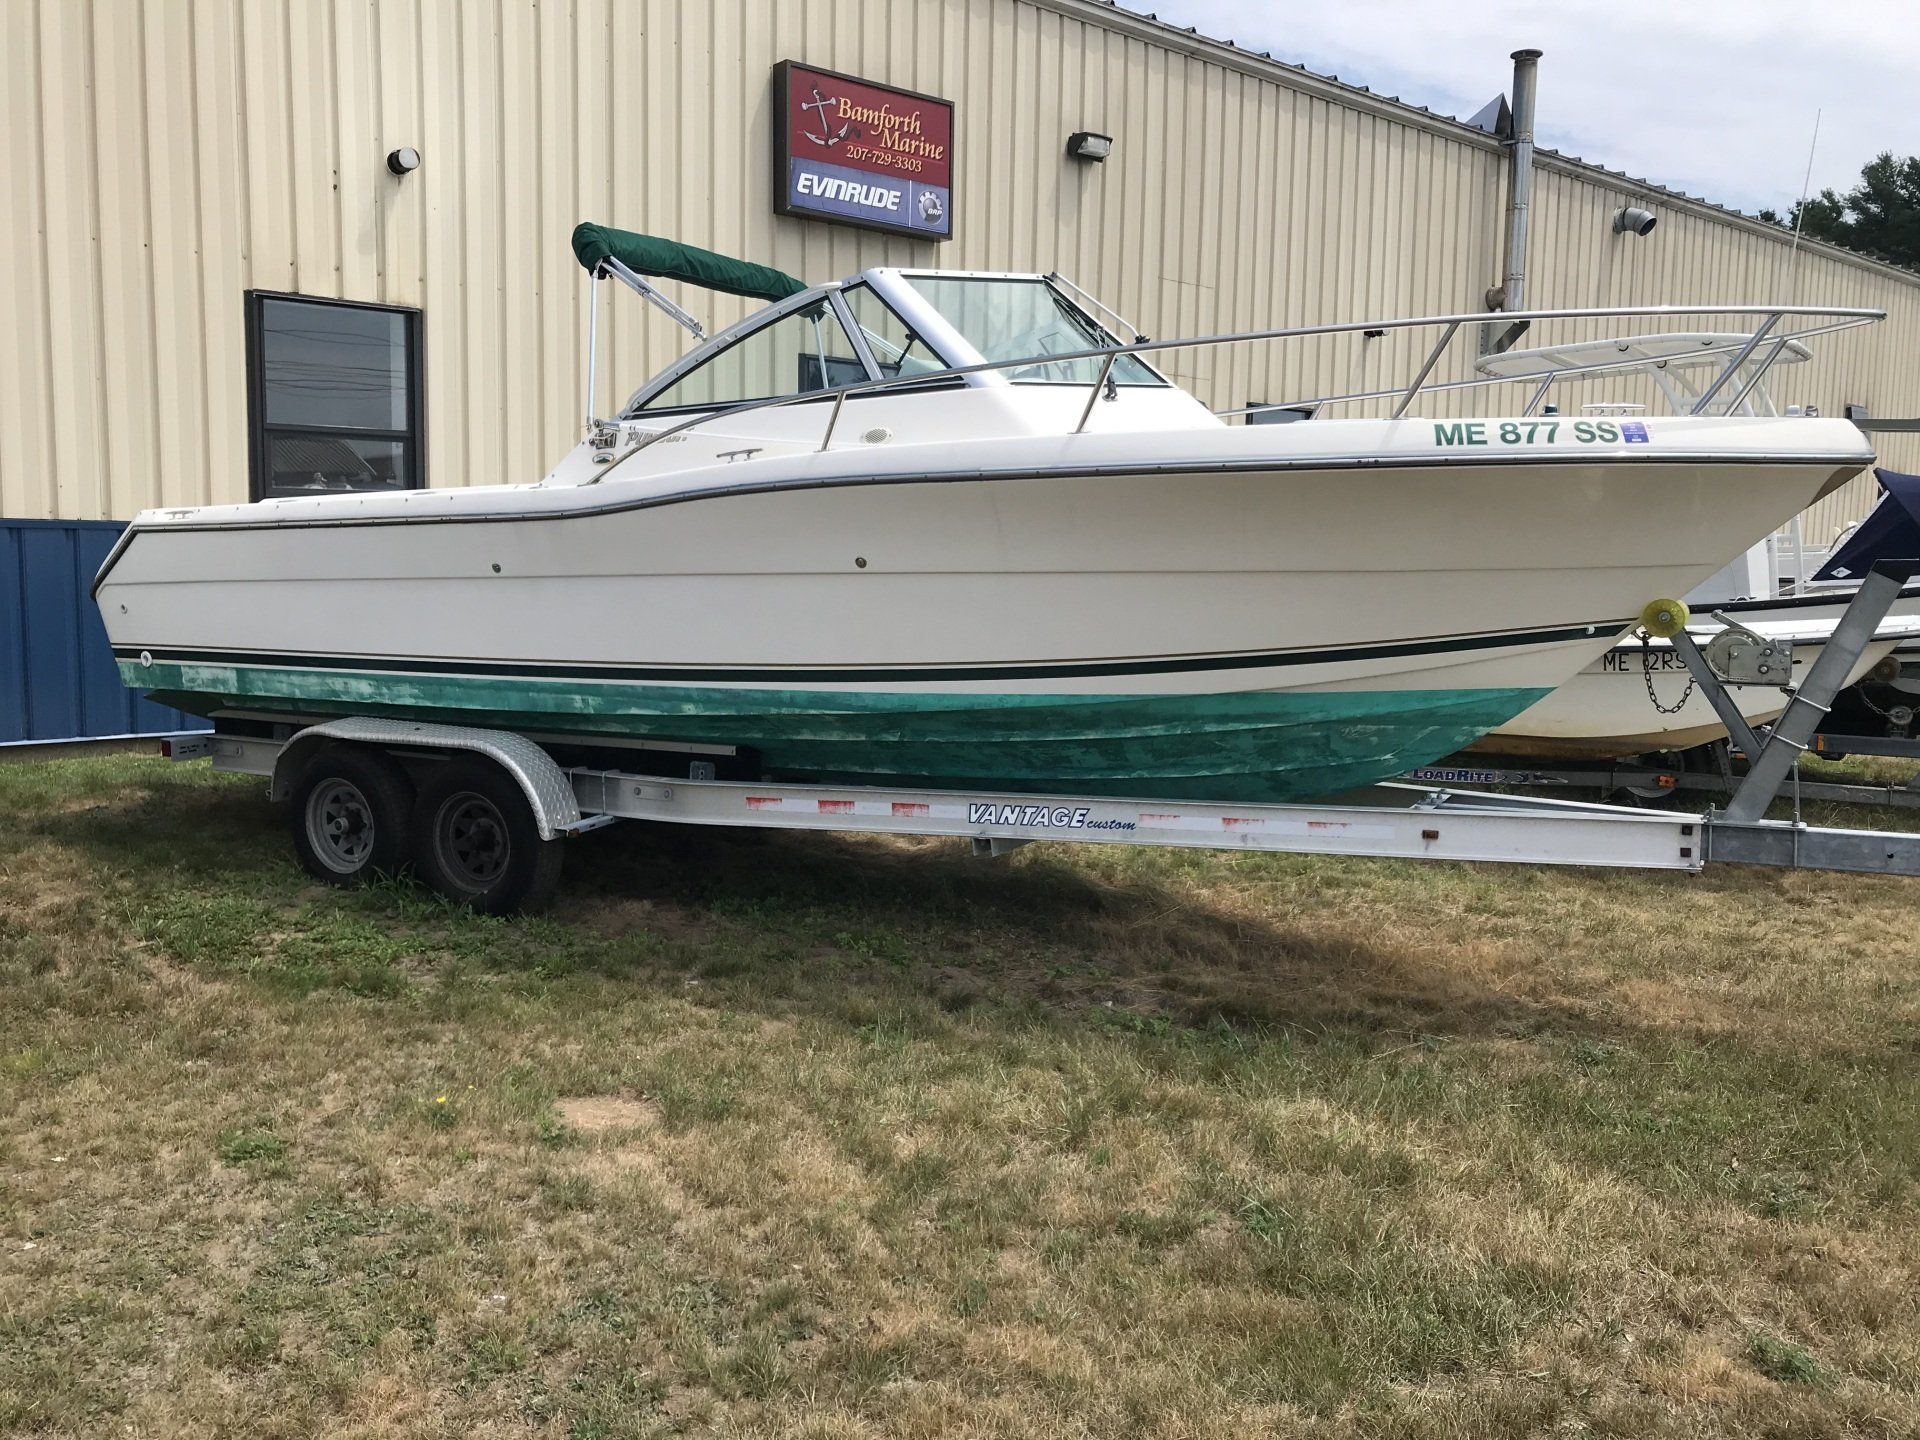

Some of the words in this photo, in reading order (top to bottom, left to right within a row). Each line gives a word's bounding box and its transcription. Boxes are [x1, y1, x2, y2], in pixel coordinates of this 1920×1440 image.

[837, 97, 921, 135] Bamforth
[880, 128, 944, 160] Marine
[847, 145, 923, 172] 207-729-3303
[797, 172, 902, 211] EVINRUDE
[927, 208, 943, 216] BRP
[1434, 423, 1488, 446] ME
[1500, 421, 1560, 445] 877
[1573, 421, 1619, 444] SS
[1603, 653, 1630, 672] ME
[1643, 652, 1687, 671] 2RS
[968, 803, 1090, 829] VANTAGE
[1087, 819, 1137, 831] custom
